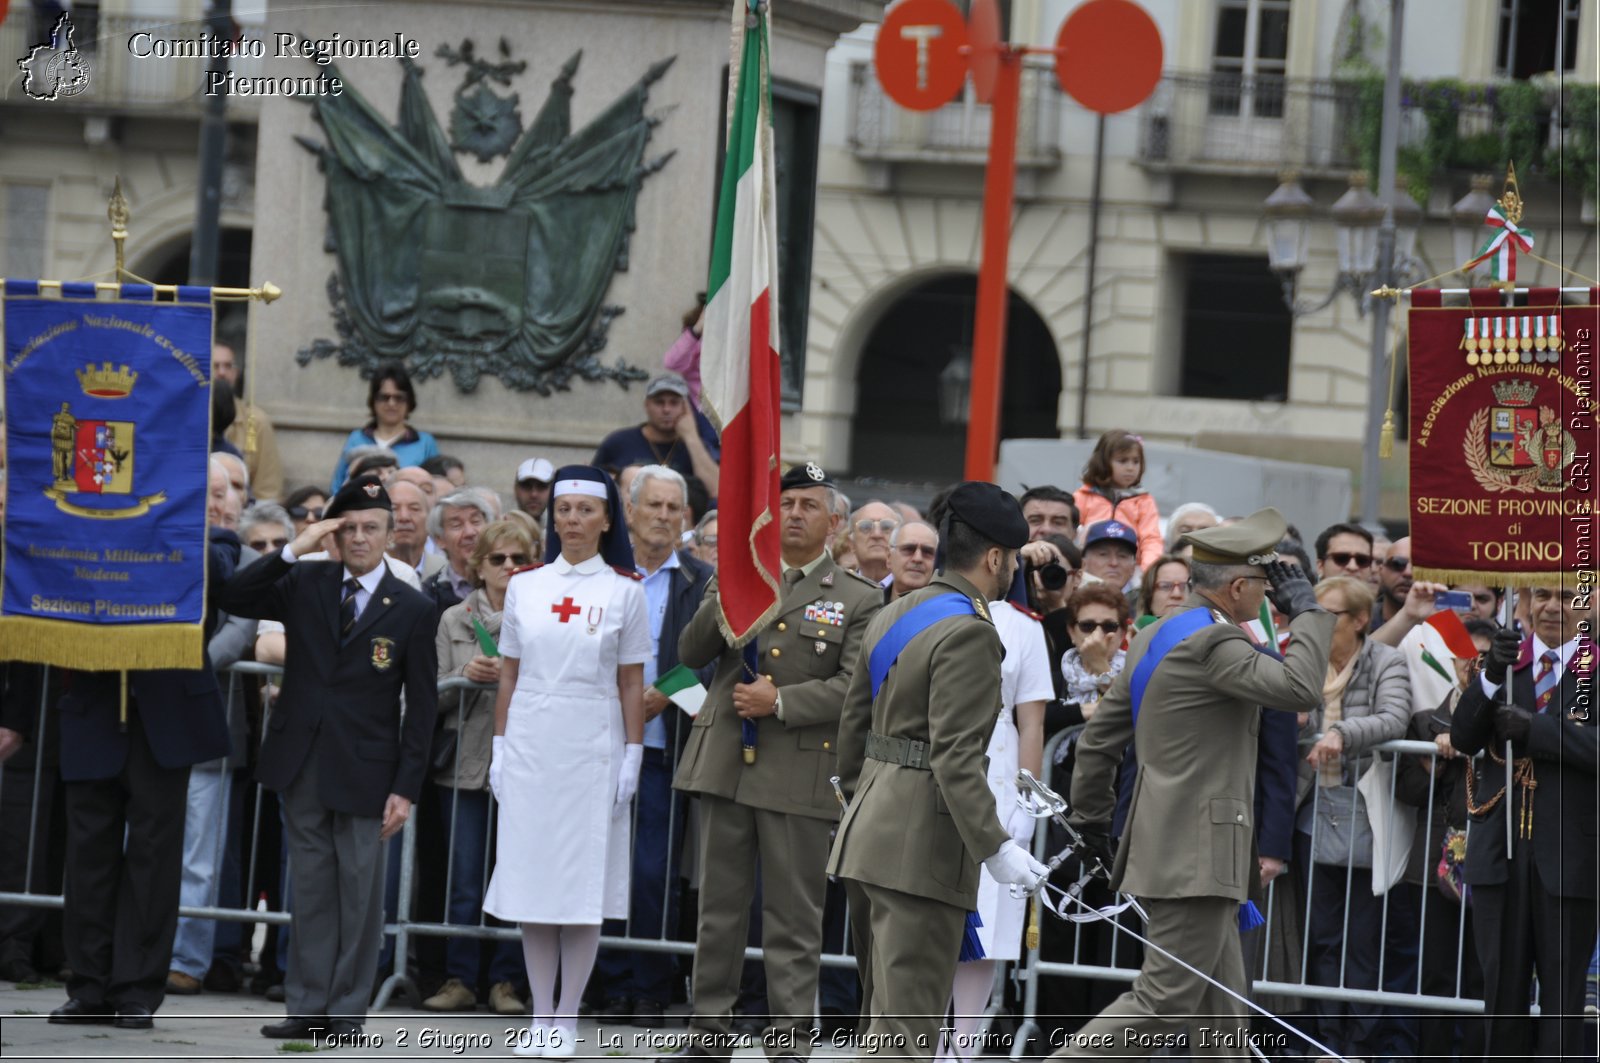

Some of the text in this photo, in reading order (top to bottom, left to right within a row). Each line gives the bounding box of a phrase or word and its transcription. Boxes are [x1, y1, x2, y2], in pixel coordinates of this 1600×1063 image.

[900, 24, 942, 90] T
[83, 314, 155, 338] Nazionale
[1417, 372, 1475, 447] Associazione
[1476, 363, 1545, 379] Nazionale
[1417, 497, 1491, 515] SEZIONE
[1508, 523, 1522, 535] di
[103, 549, 164, 563] Militare
[168, 550, 183, 563] di
[1468, 541, 1563, 561] TORINO
[74, 566, 130, 581] Modena
[31, 594, 176, 616] Sezione Piemonte
